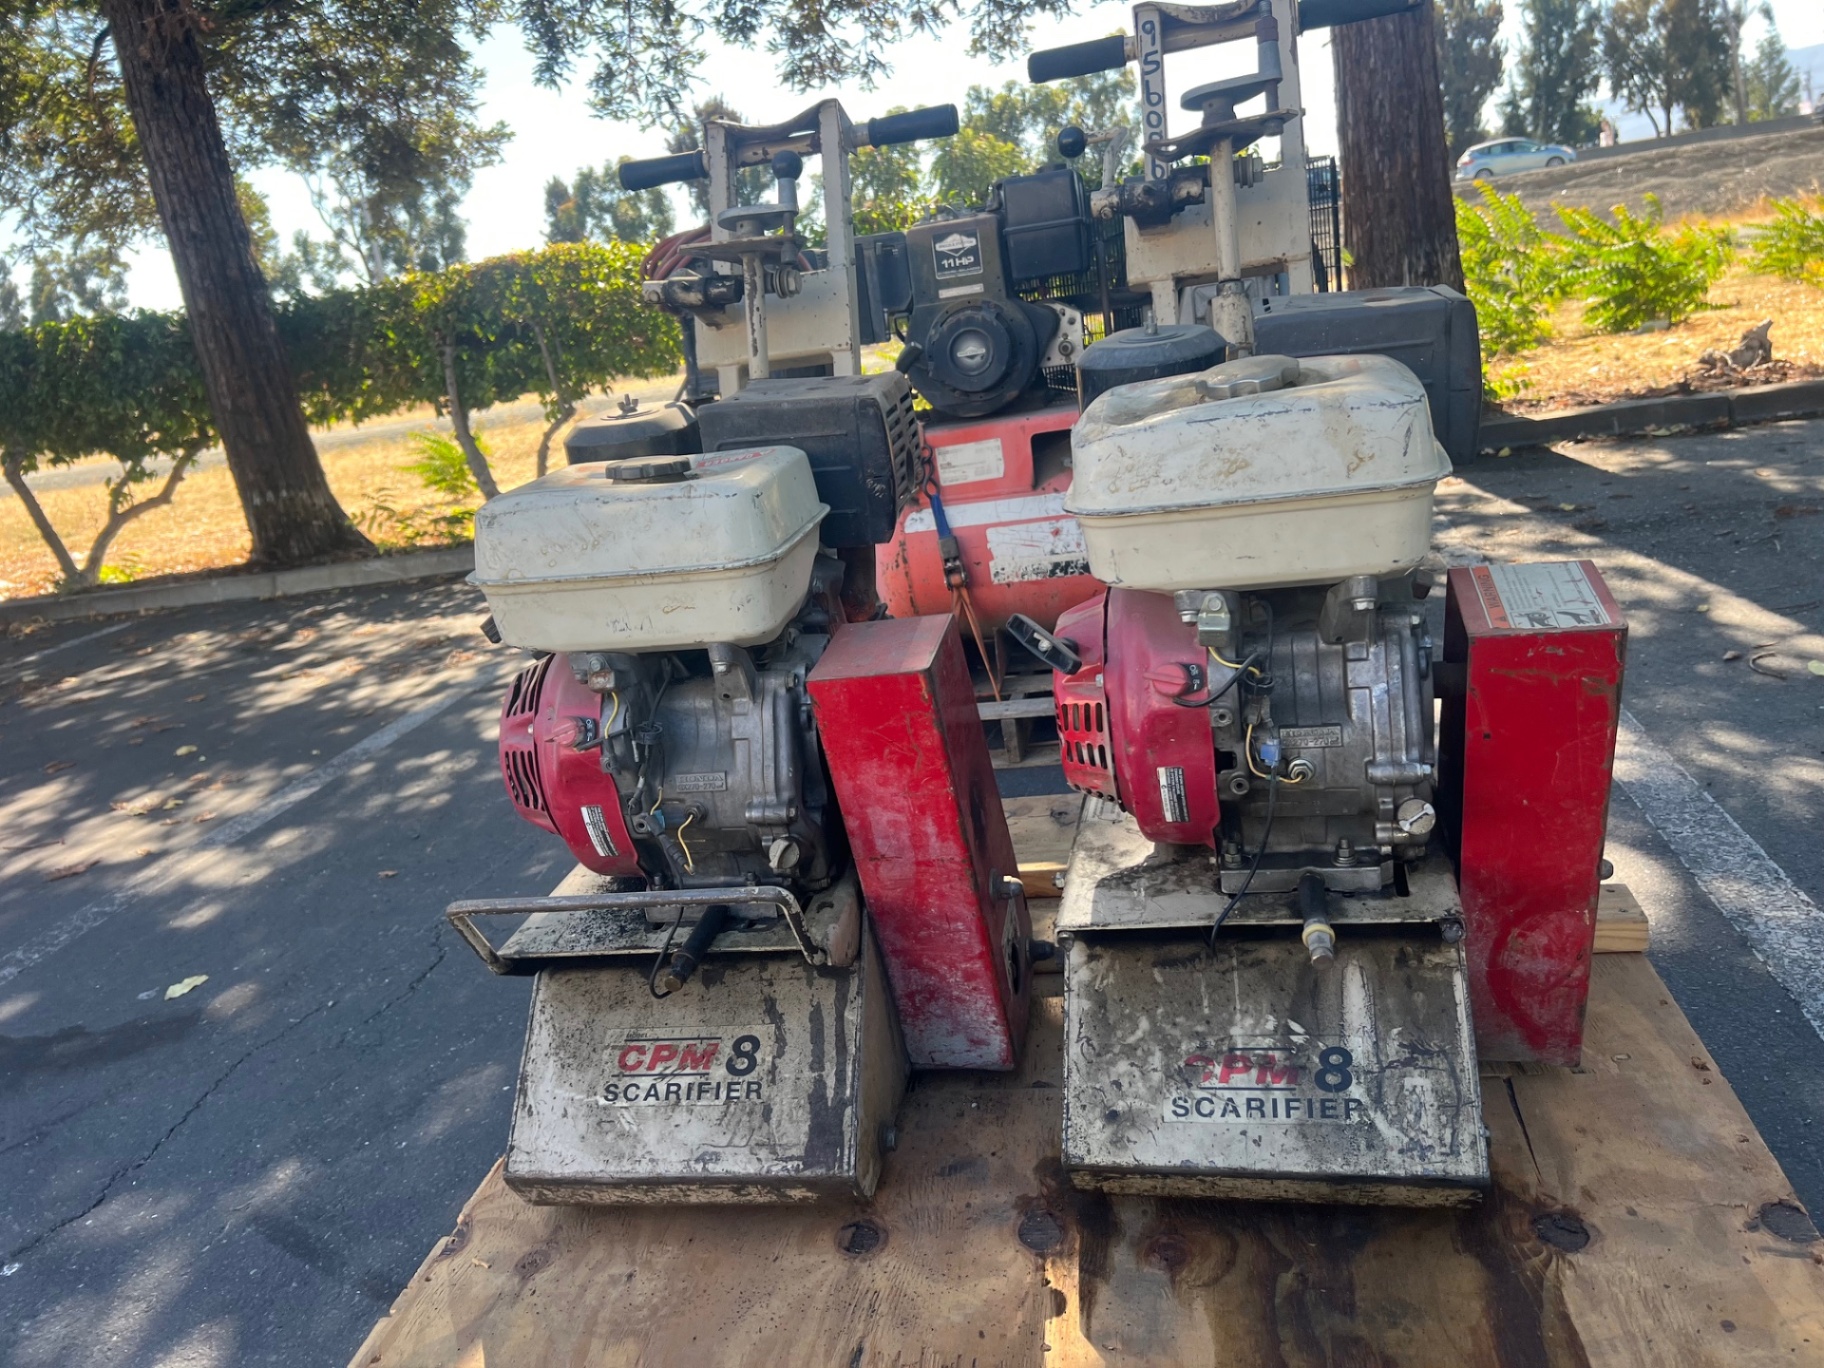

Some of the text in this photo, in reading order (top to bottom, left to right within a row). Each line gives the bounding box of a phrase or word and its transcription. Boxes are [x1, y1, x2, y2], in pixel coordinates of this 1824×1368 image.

[1477, 573, 1501, 609] WARNING
[617, 1034, 761, 1077] CPM 8
[1314, 1046, 1353, 1093] 8
[603, 1080, 763, 1102] SCARIFIER
